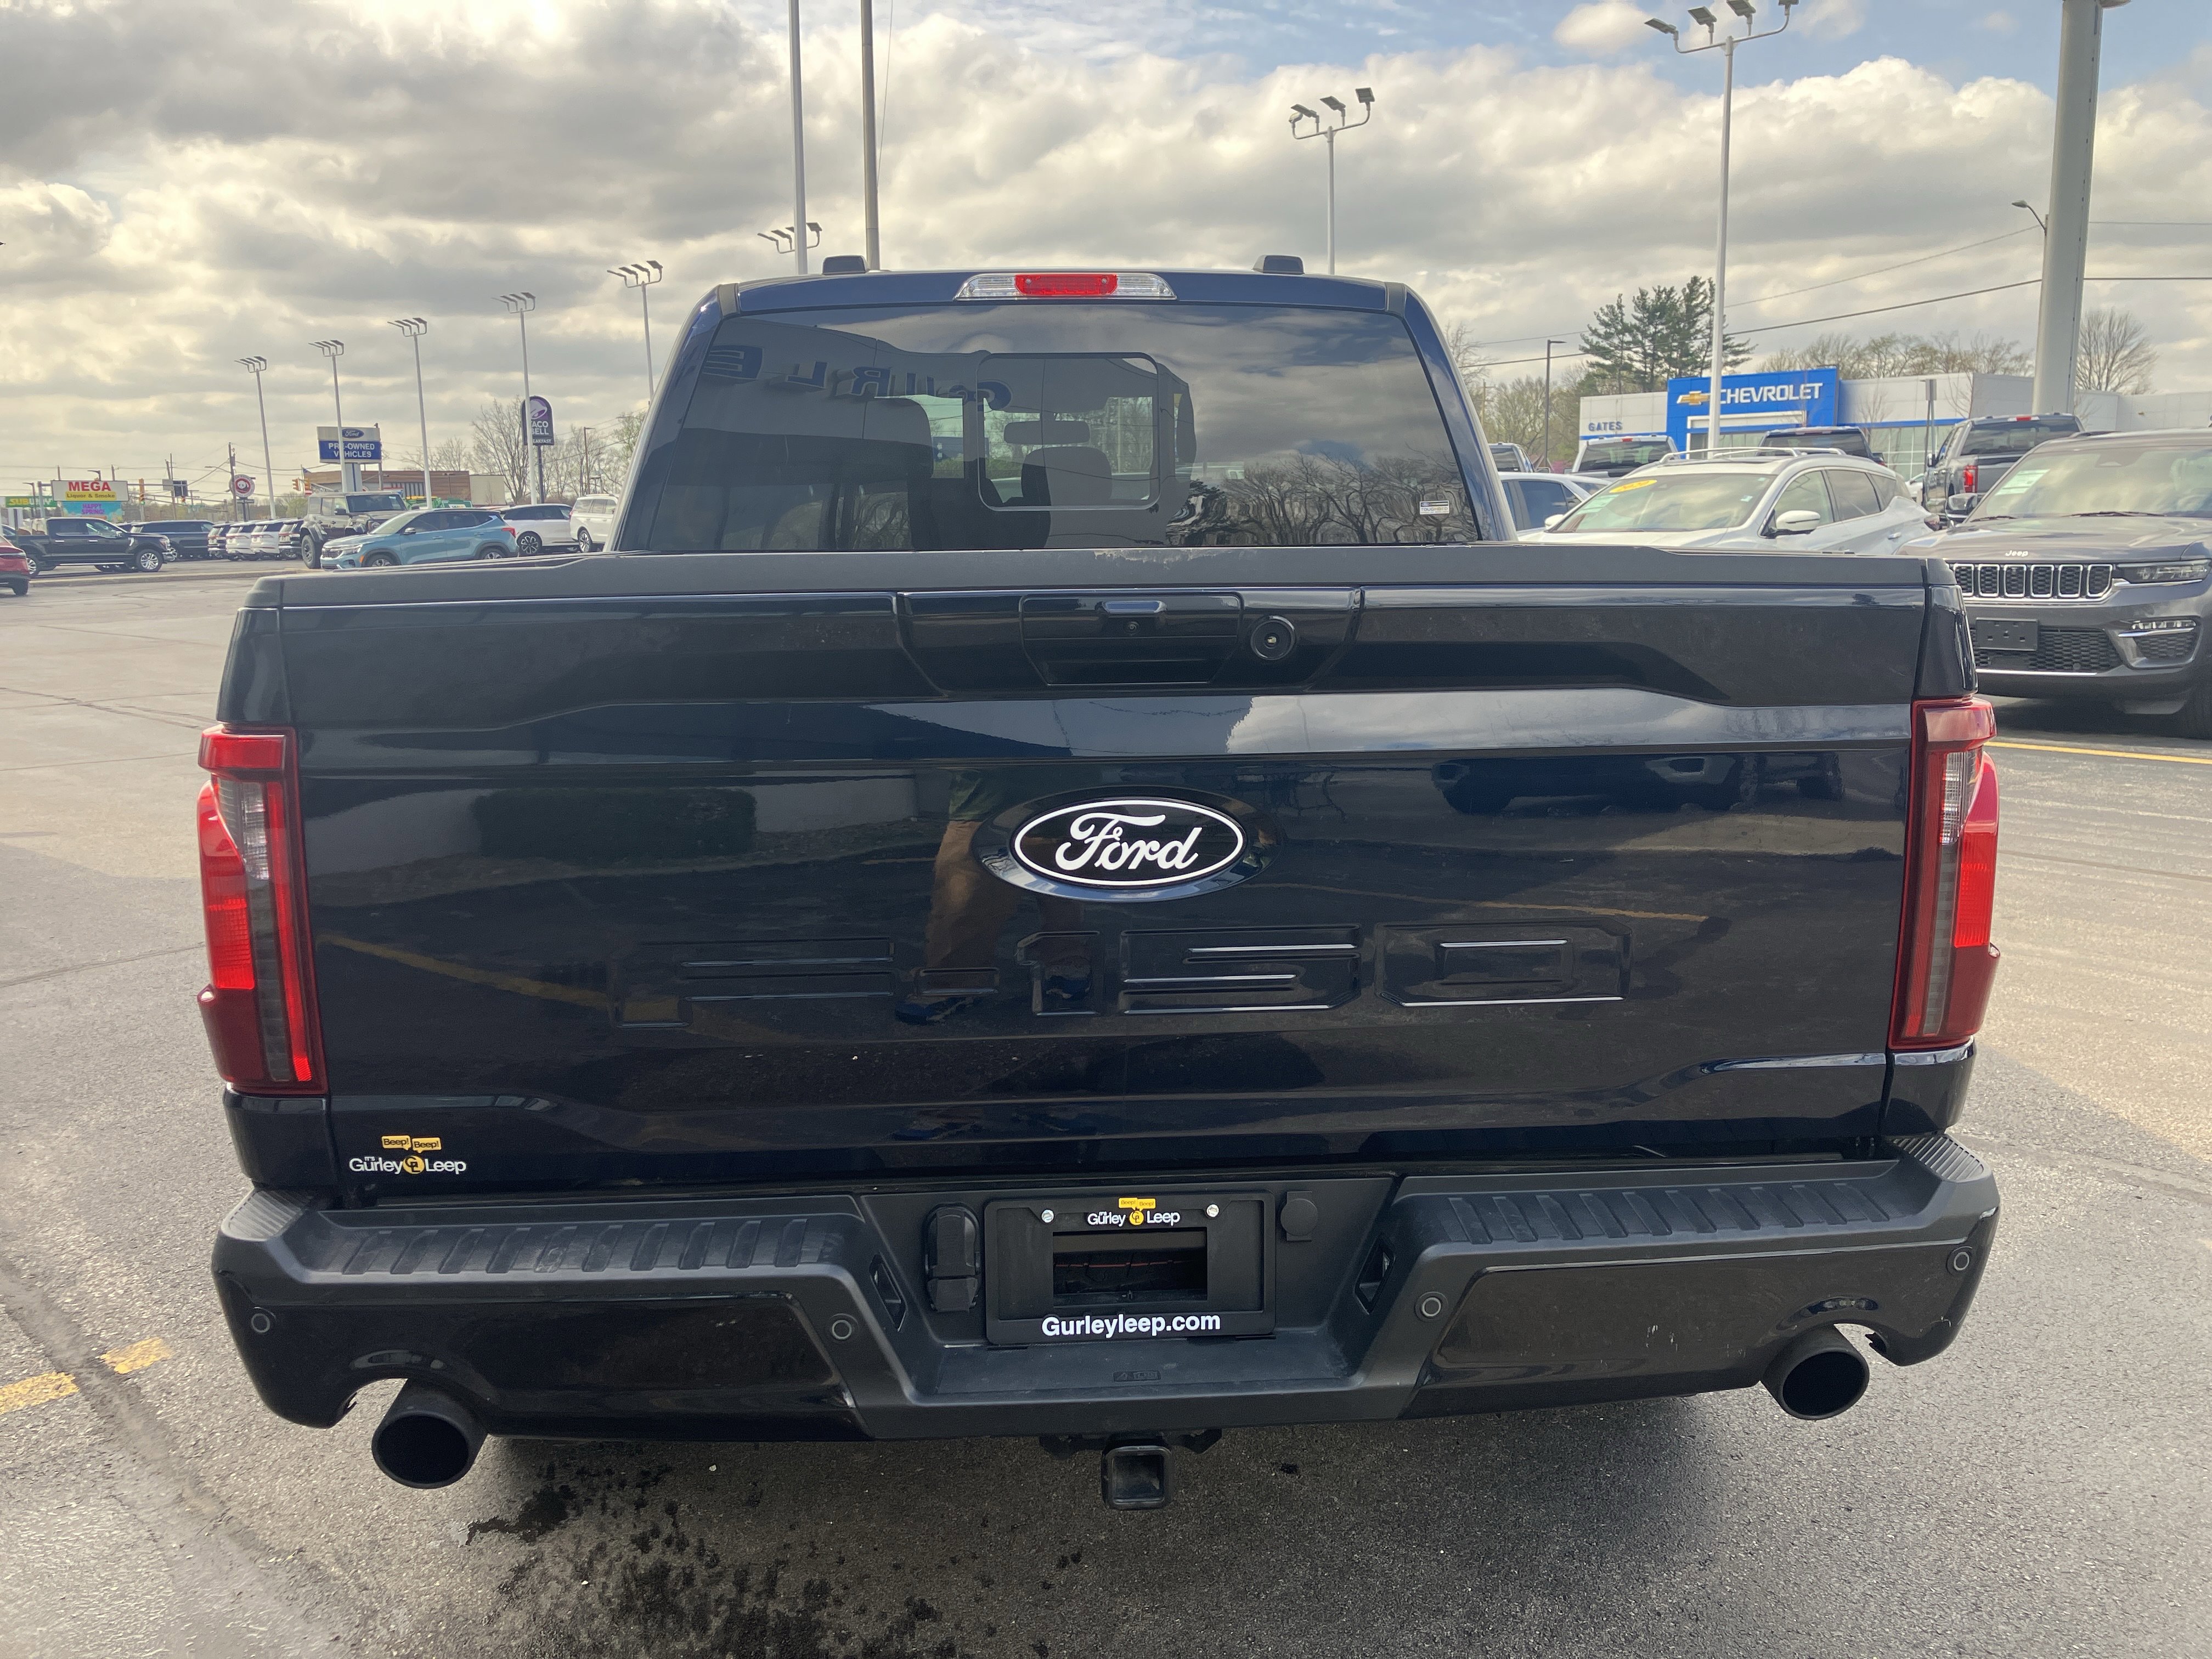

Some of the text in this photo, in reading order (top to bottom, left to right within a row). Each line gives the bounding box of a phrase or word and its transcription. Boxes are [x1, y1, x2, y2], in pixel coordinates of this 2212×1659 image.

[1720, 383, 1823, 404] CHEVROLET
[1588, 421, 1623, 432] GATES
[68, 482, 111, 491] MEGA
[1055, 812, 1203, 871] Ford
[610, 921, 1633, 1028] F-150
[384, 1137, 409, 1146] Beep!
[414, 1140, 439, 1149] Beep!
[425, 1159, 466, 1175] Leep
[1147, 1210, 1181, 1226] Leep
[1042, 1314, 1221, 1339] Gurleyleep.com
